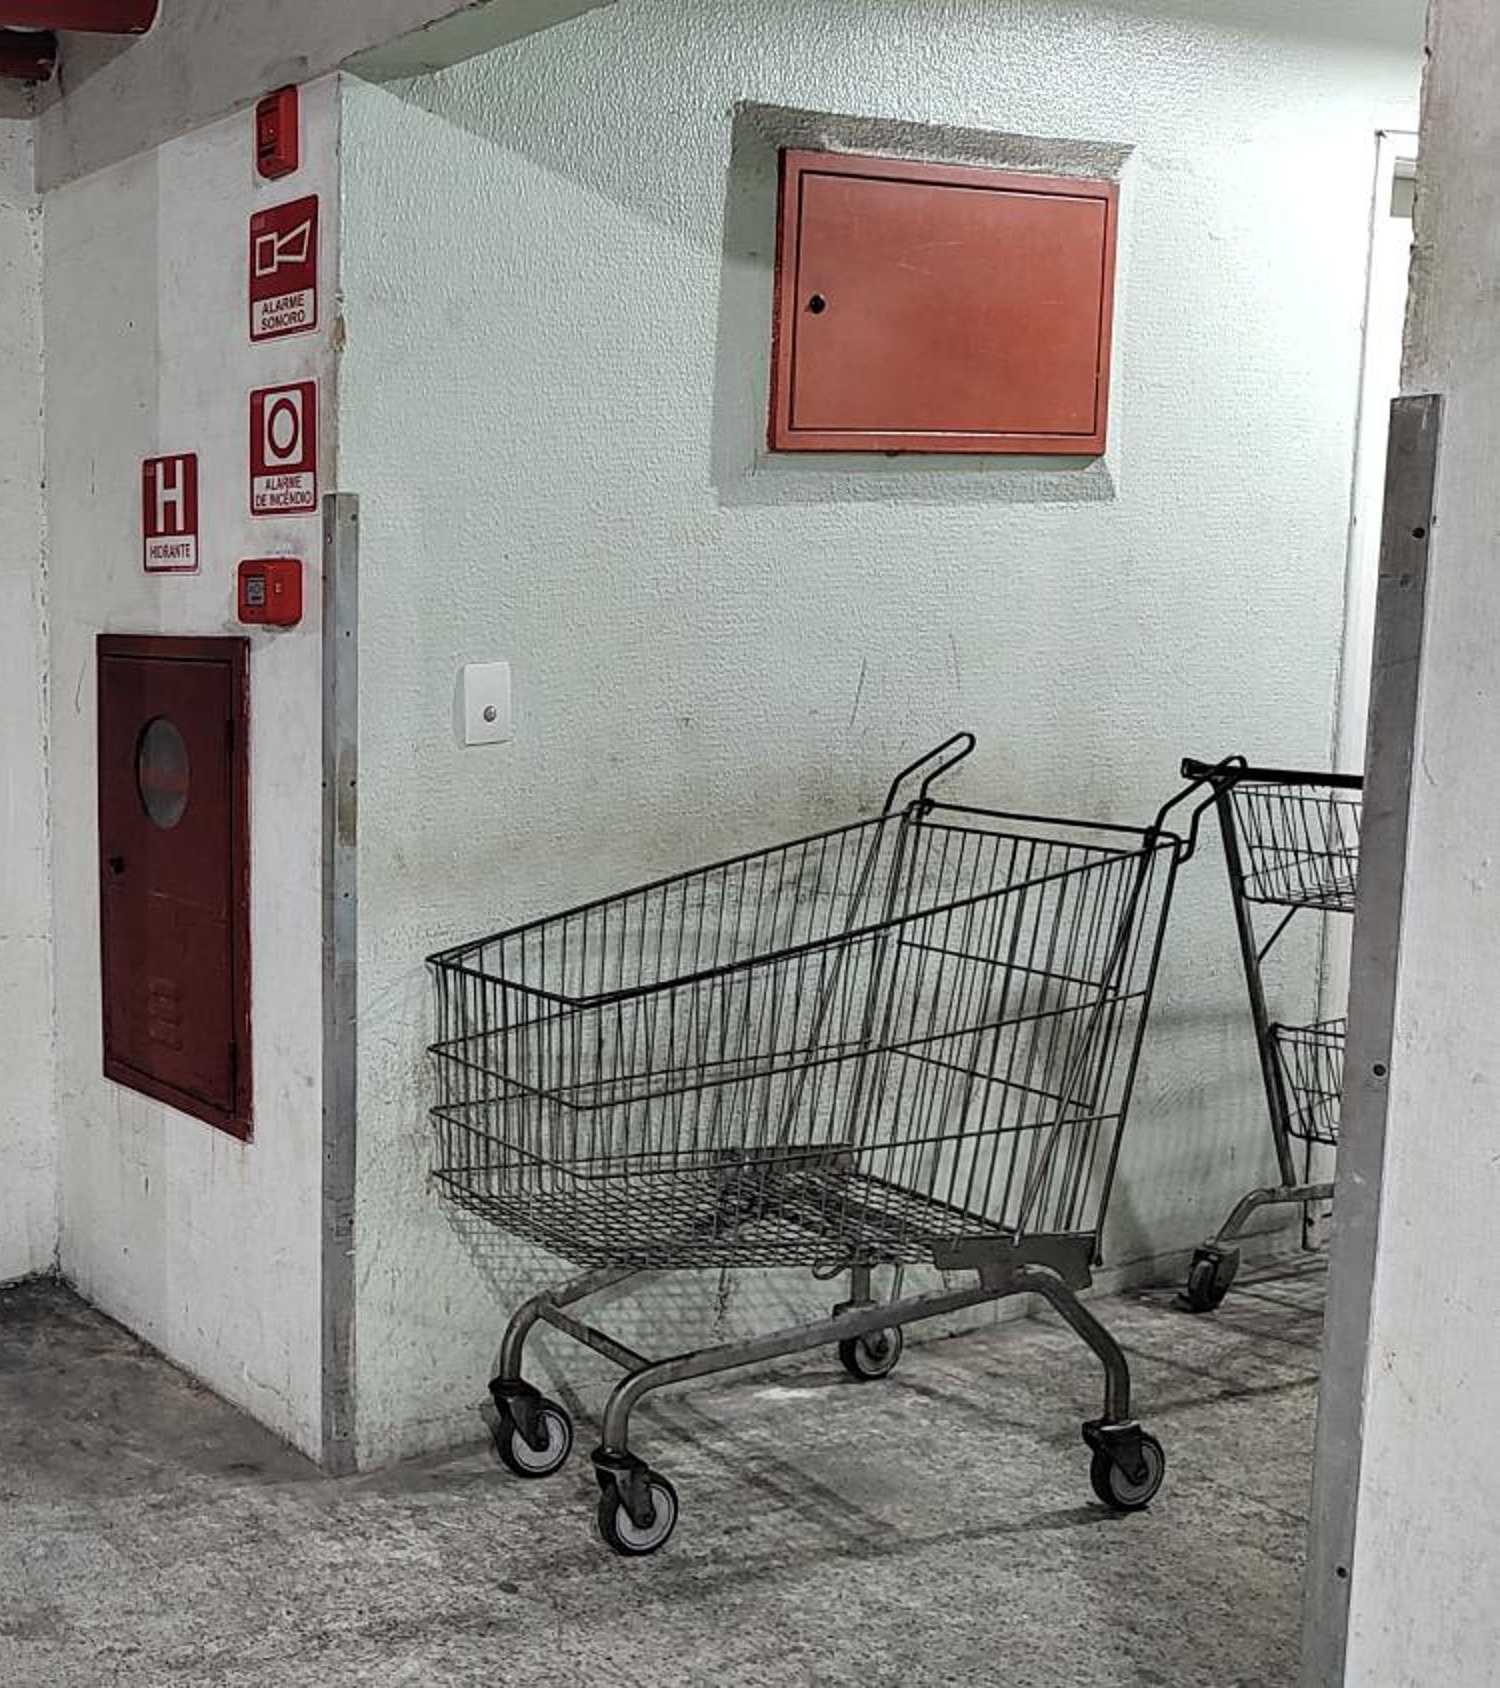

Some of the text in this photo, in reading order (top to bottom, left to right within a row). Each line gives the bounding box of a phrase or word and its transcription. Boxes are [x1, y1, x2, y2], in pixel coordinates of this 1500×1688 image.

[261, 293, 305, 315] ALARME
[261, 309, 305, 331] SONORO
[265, 475, 302, 491] ALARME
[155, 459, 184, 533] H
[255, 493, 267, 507] DE
[149, 543, 192, 559] HIDRANTE
